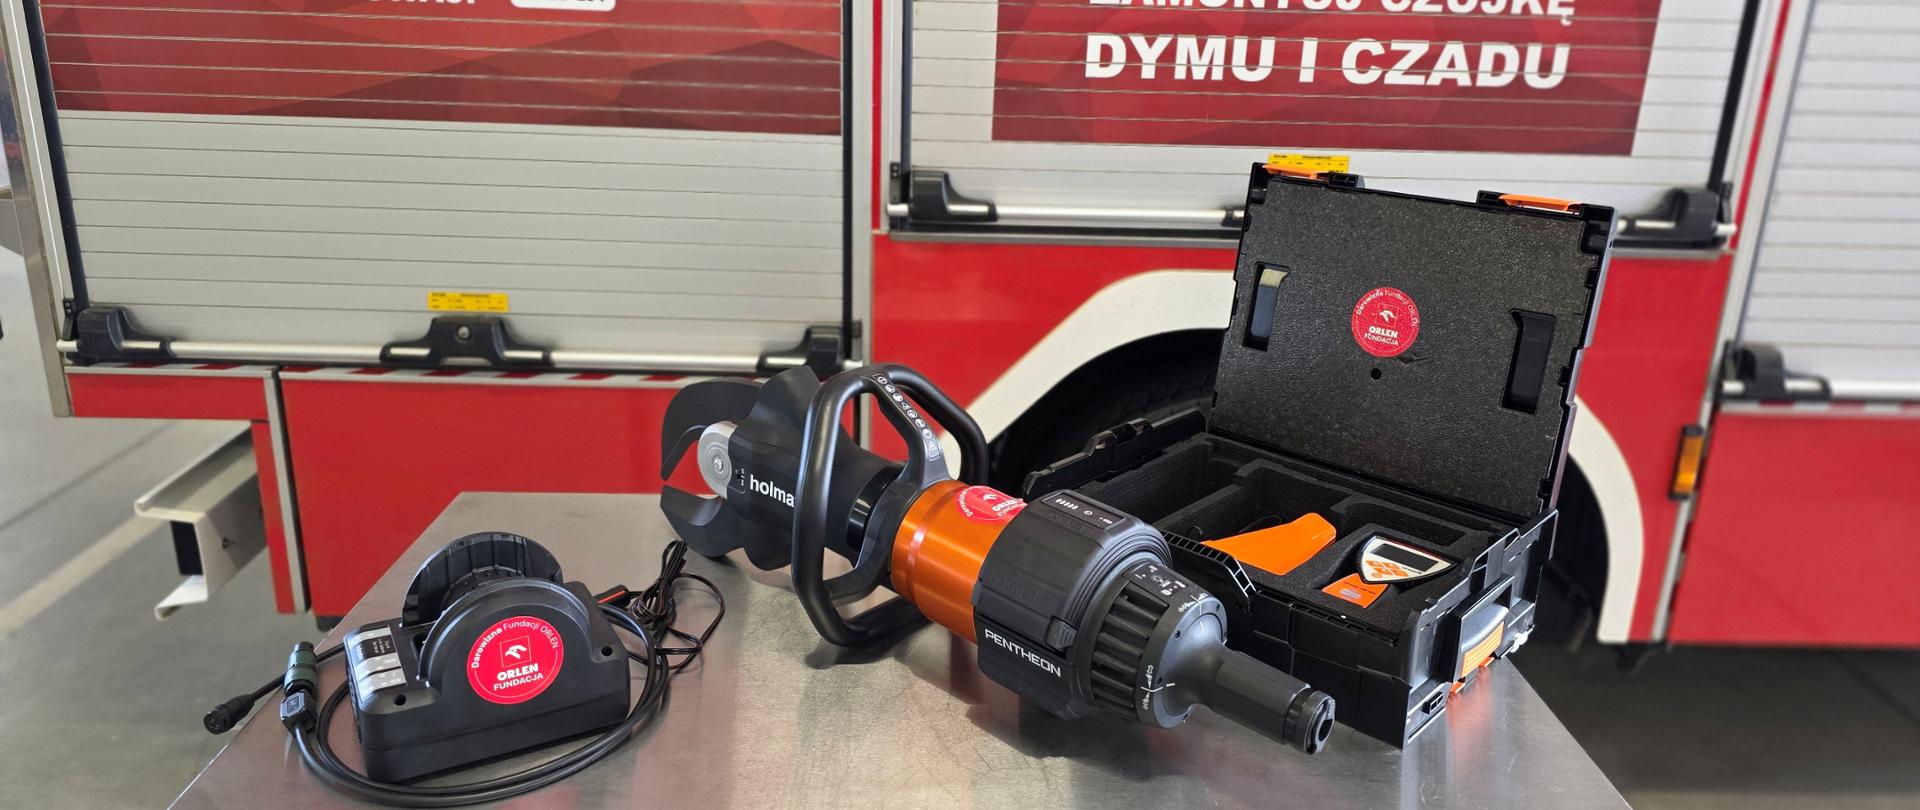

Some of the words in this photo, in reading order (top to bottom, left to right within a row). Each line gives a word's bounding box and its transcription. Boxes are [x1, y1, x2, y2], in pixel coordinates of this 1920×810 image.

[1085, 32, 1276, 82] DYMU
[1299, 37, 1318, 82] I
[1341, 38, 1570, 89] CZADU
[1369, 326, 1398, 338] ORLEN
[749, 473, 795, 508] holma
[471, 627, 503, 669] Darowizna
[503, 620, 540, 631] Fundacji
[540, 625, 559, 649] ORLEN
[984, 628, 1061, 678] PENTHEON
[493, 672, 544, 691] FUNDACJA
[497, 663, 539, 681] ORLEN
